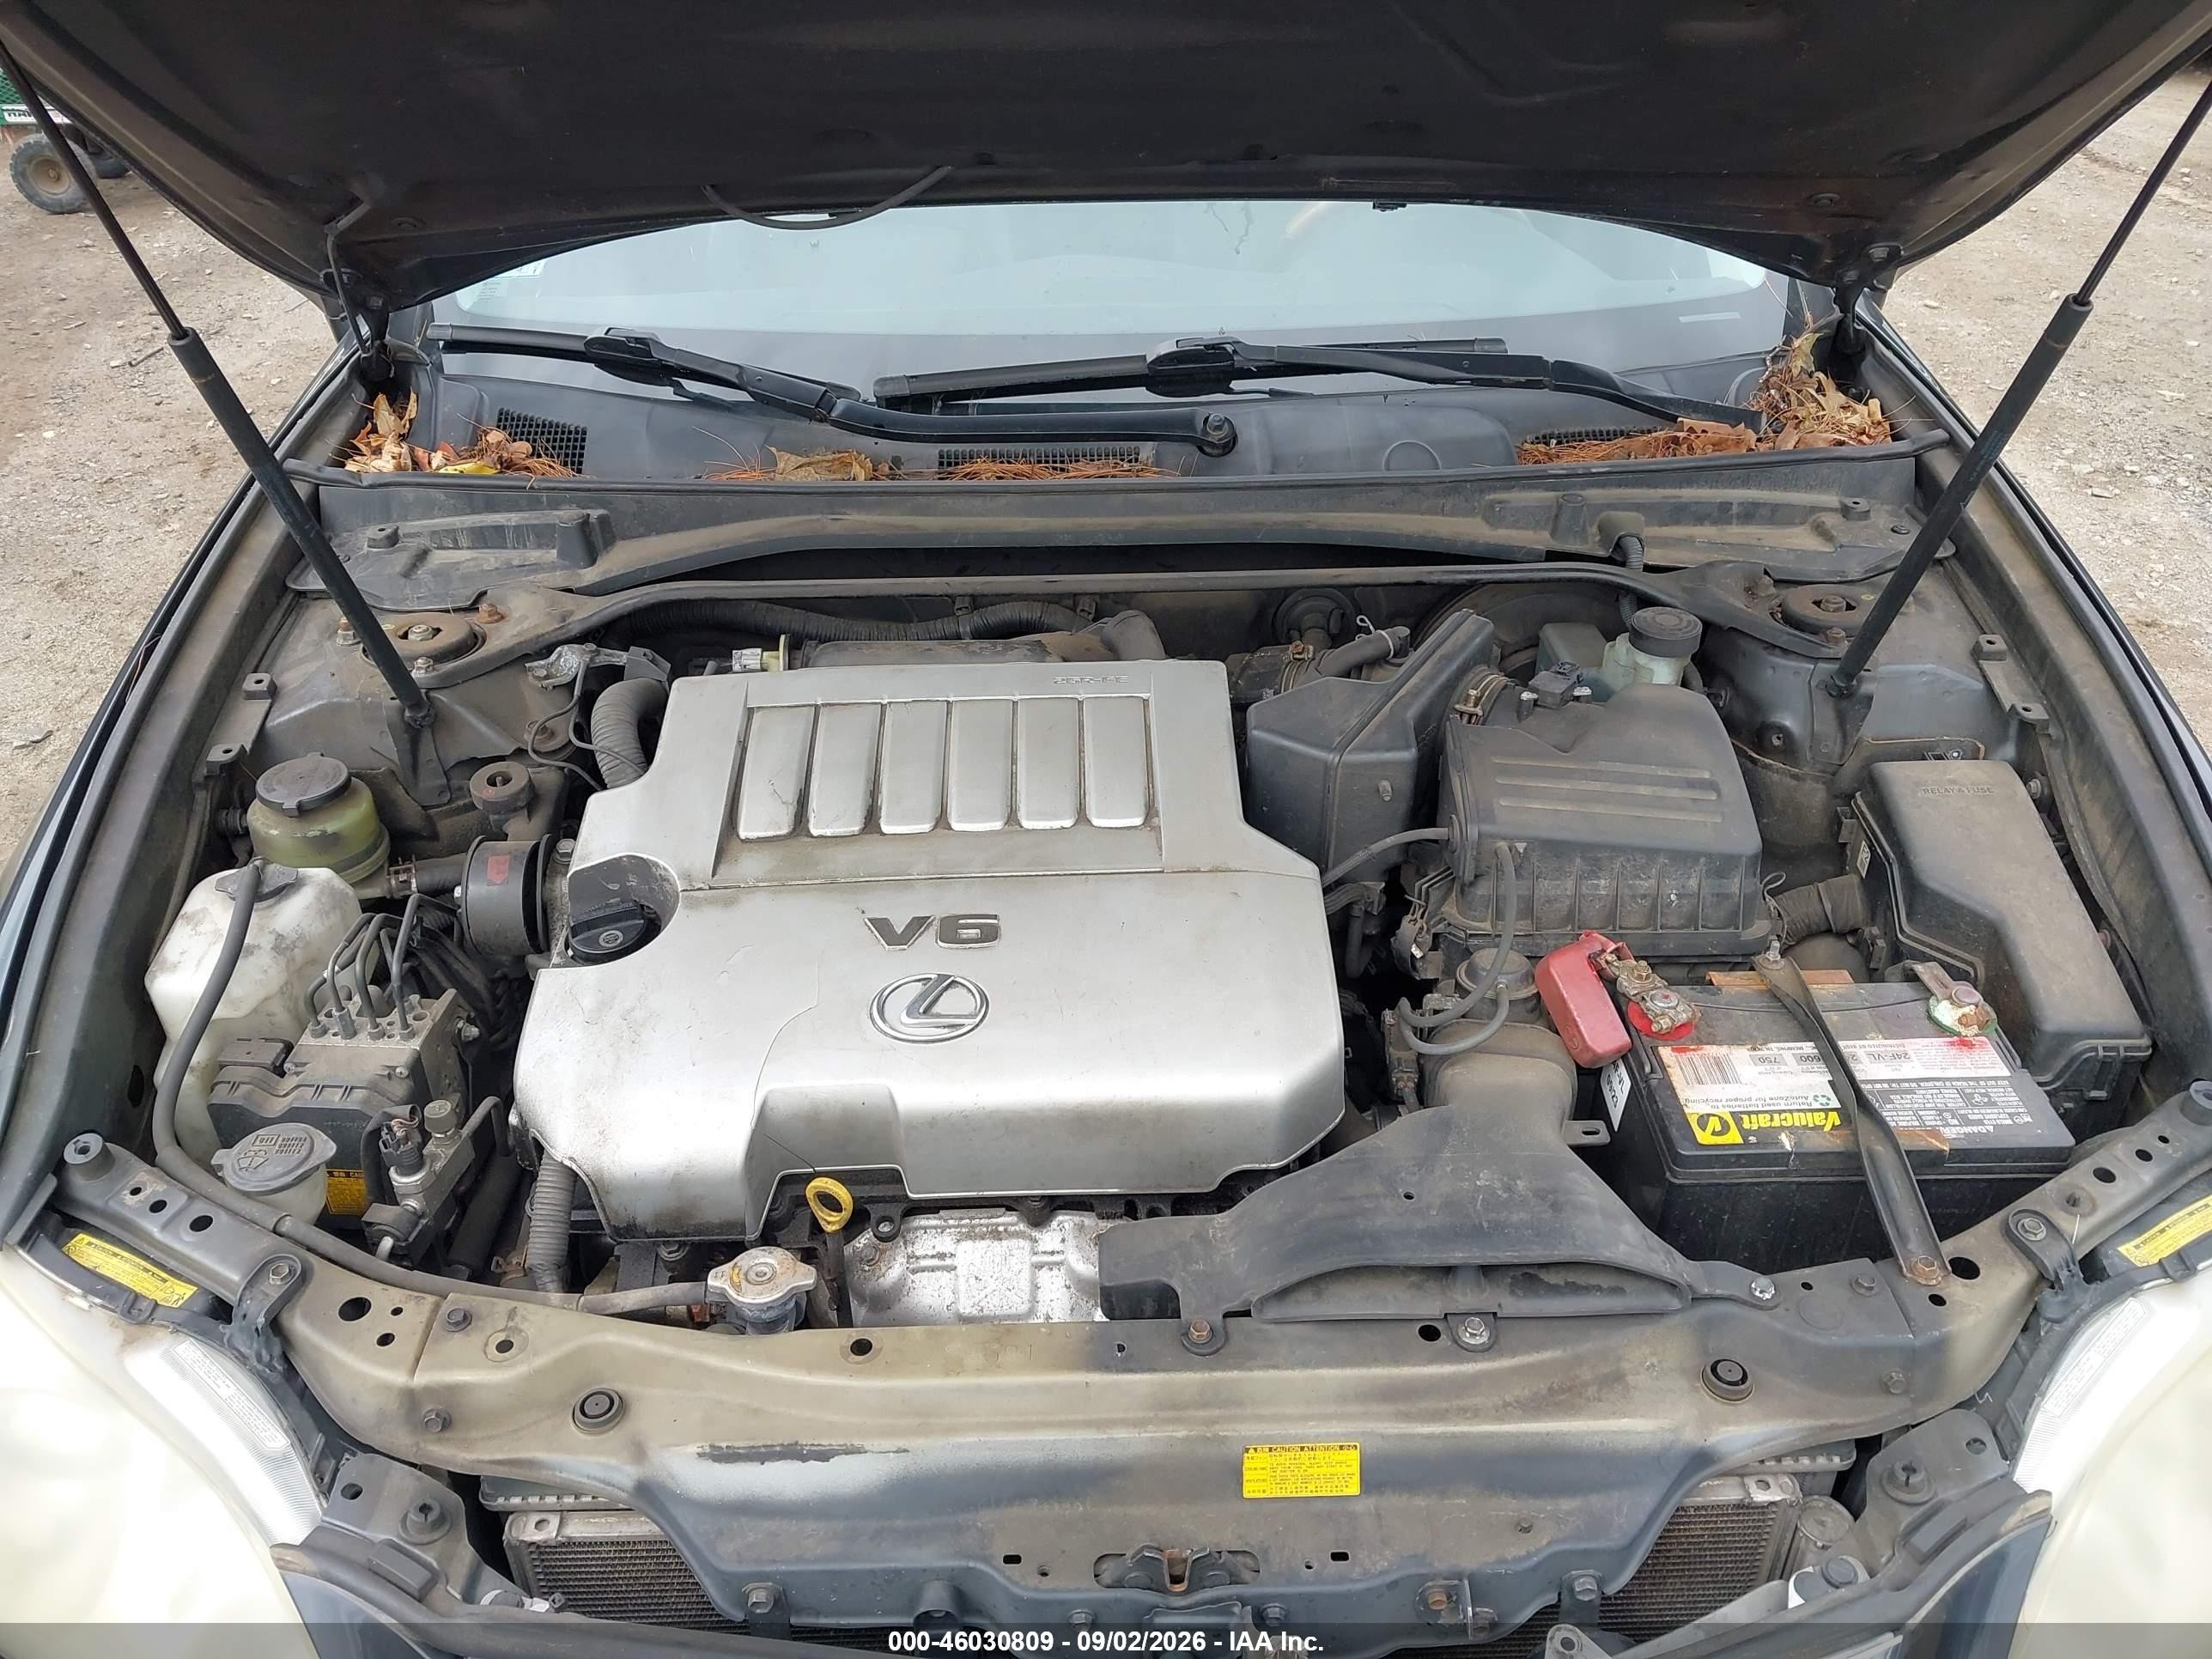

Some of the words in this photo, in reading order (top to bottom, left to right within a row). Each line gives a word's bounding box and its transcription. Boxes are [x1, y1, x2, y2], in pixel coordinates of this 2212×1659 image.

[1922, 787, 1954, 795] RELAY
[863, 914, 1000, 951] V6
[1741, 1110, 1841, 1132] Valucraft
